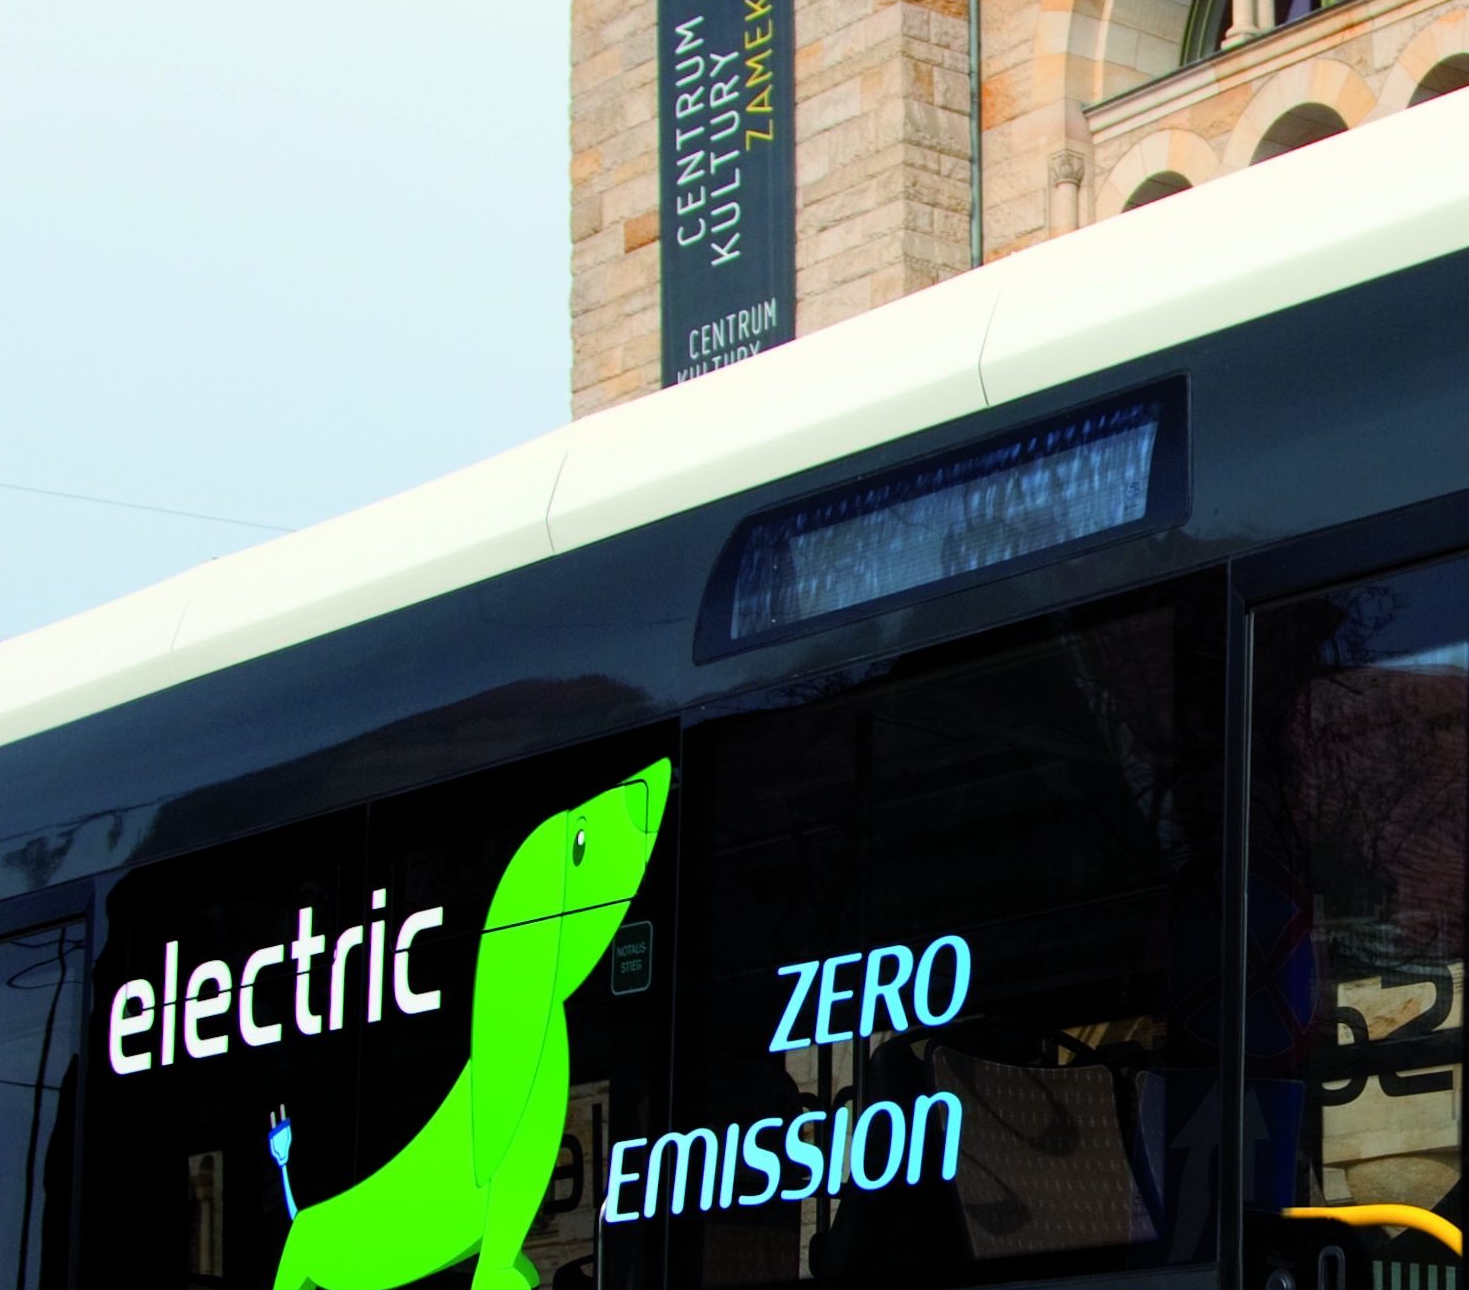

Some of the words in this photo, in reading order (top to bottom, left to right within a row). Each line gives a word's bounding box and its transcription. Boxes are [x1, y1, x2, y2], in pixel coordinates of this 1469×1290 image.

[675, 15, 706, 246] CENTRUM
[709, 51, 740, 266] KULTURY
[689, 297, 777, 360] CENTRUM
[108, 888, 444, 1076] electric
[768, 934, 972, 1054] ZERO
